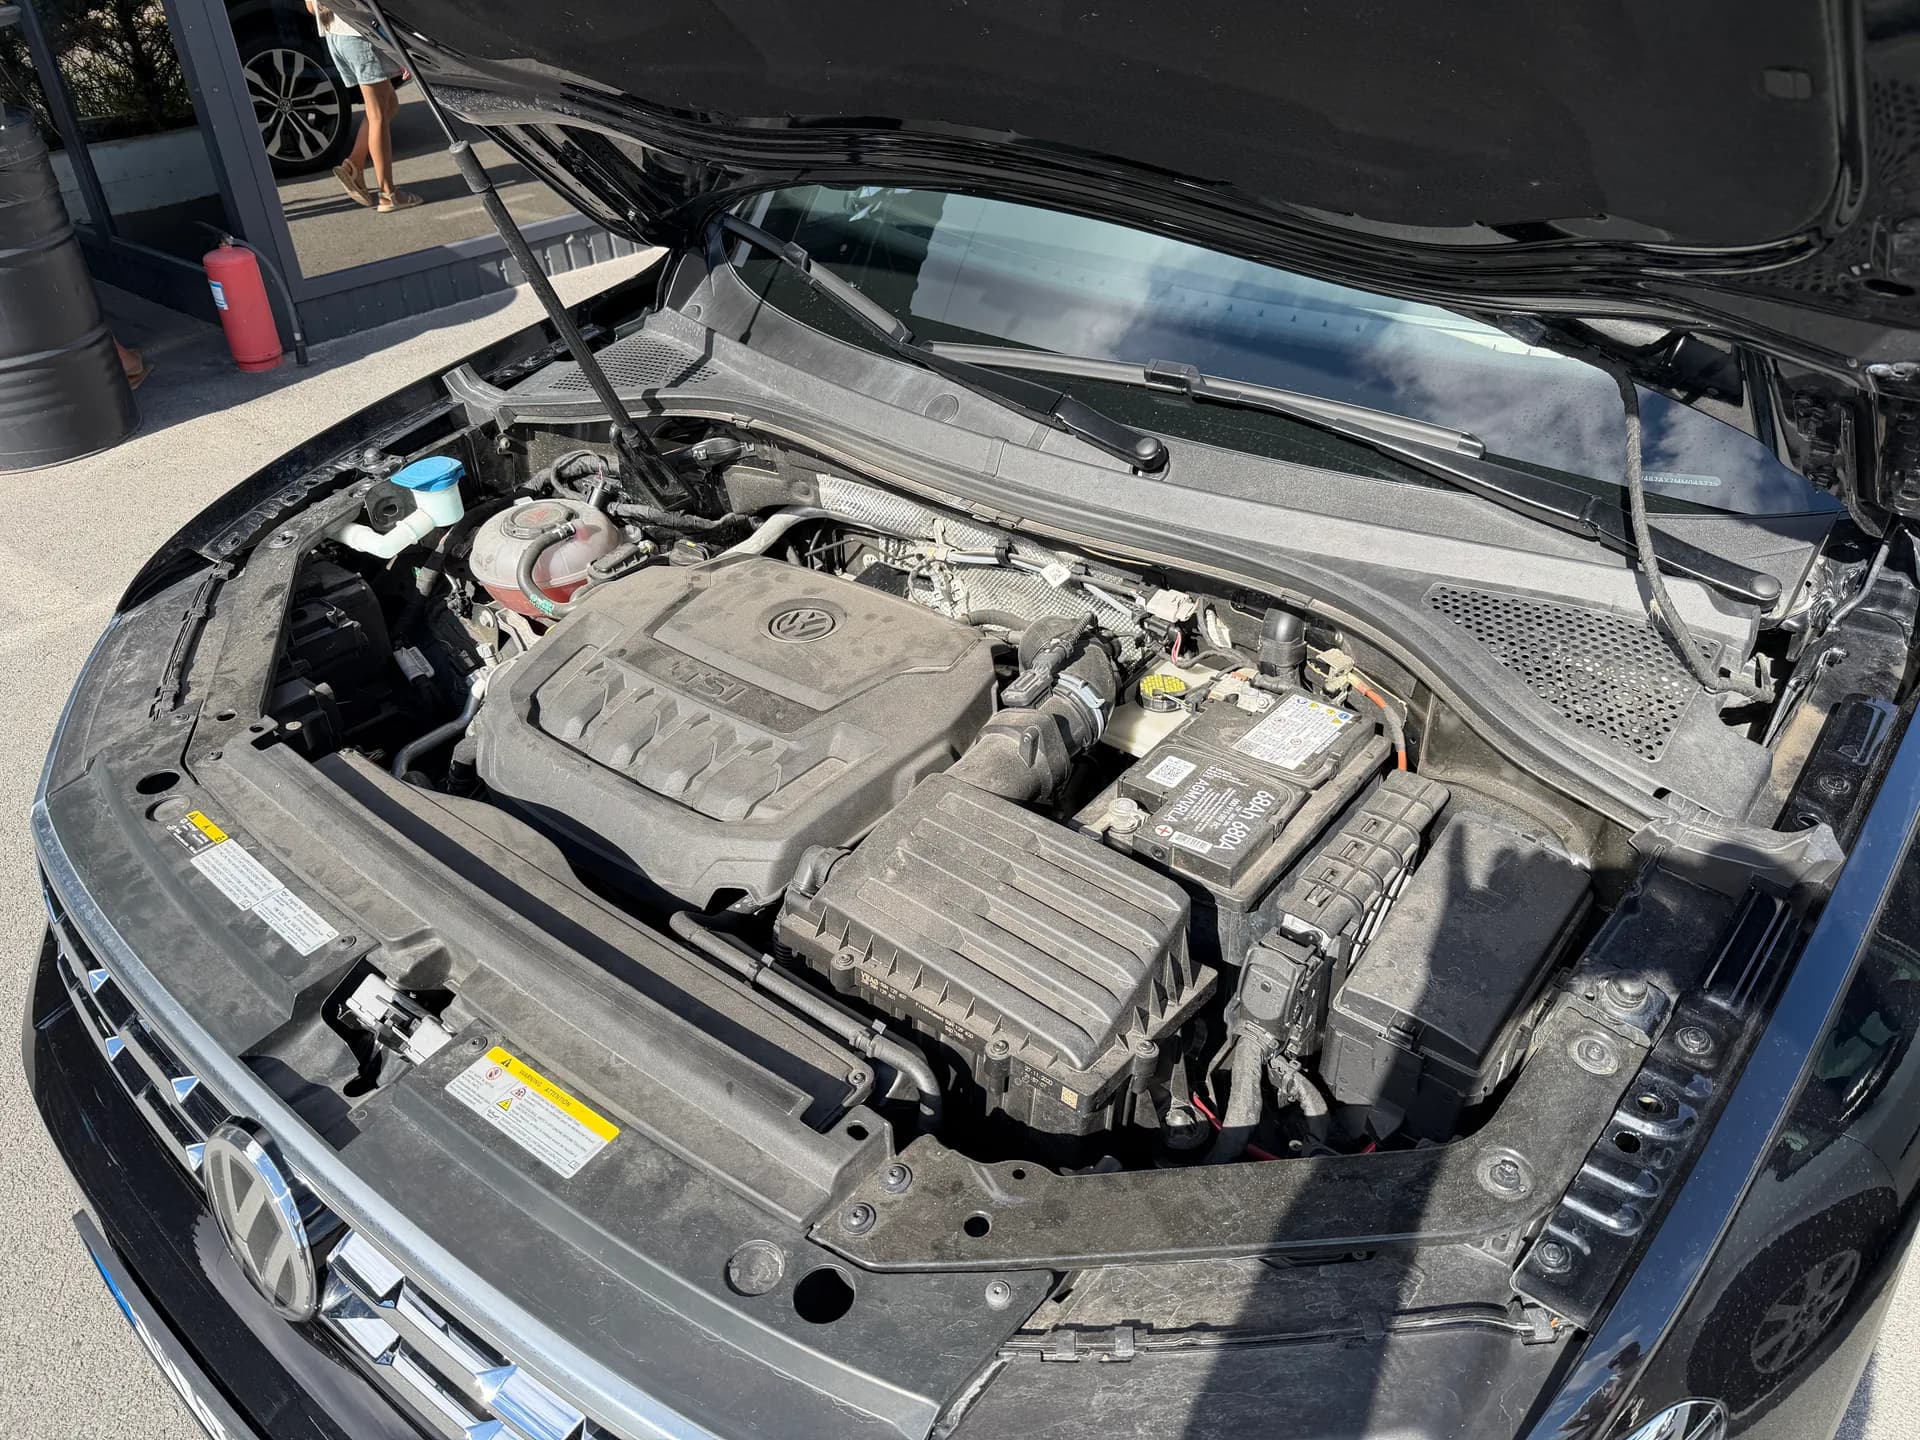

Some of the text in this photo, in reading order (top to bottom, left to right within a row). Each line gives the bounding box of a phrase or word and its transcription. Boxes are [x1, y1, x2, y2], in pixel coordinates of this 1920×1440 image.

[672, 660, 747, 703] TSI
[1161, 778, 1209, 823] AGM/VRLA
[1242, 790, 1276, 820] 68Ah
[1214, 821, 1250, 850] 680A
[518, 1070, 572, 1108] WARNING ATTENTION
